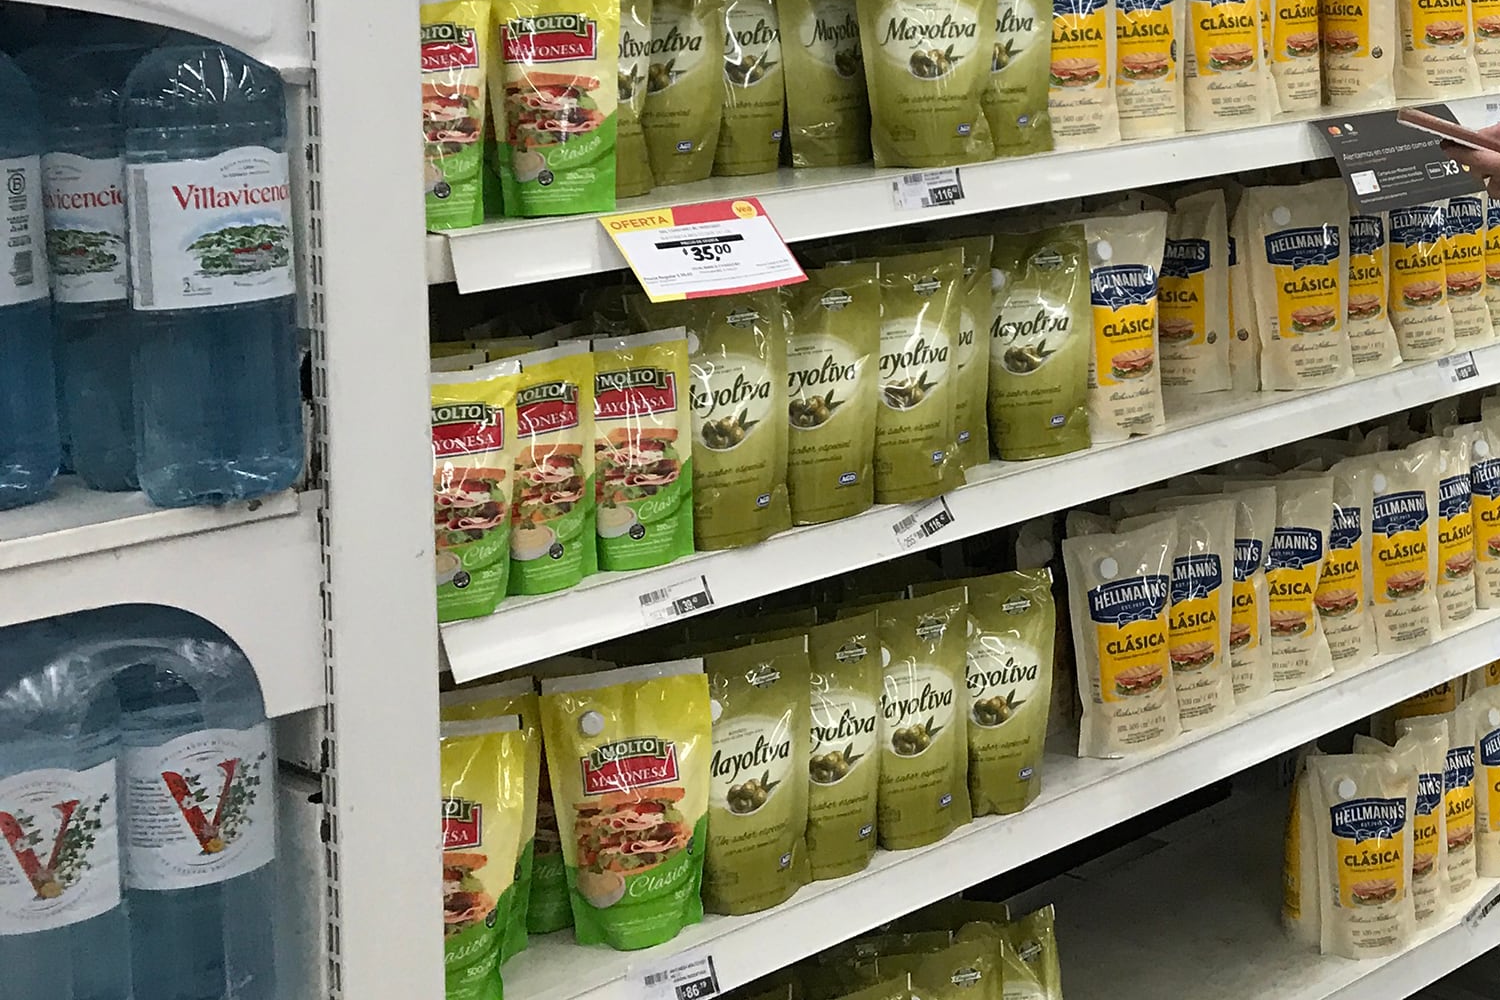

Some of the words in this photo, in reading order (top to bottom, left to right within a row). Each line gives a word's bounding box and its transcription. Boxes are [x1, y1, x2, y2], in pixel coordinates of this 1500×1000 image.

[422, 24, 450, 39] OLTO
[521, 16, 576, 31] MOLTO
[1052, 25, 1103, 43] LÁSICA
[507, 43, 585, 57] MAYONESA
[422, 52, 467, 67] ONESA
[610, 215, 669, 231] OFERTA
[600, 370, 653, 388] MOLTO
[1272, 534, 1317, 551] MANN'S
[1172, 559, 1218, 581] LMANN'S
[1094, 581, 1168, 611] HELLMANN'S
[1269, 581, 1312, 596] ÁSICA
[1170, 610, 1216, 631] LÁSICA
[1106, 631, 1165, 655] CLÁSICA
[601, 739, 655, 760] MOLTO
[1334, 800, 1406, 827] HELLMANN'S
[1344, 848, 1401, 868] CLÁSICA
